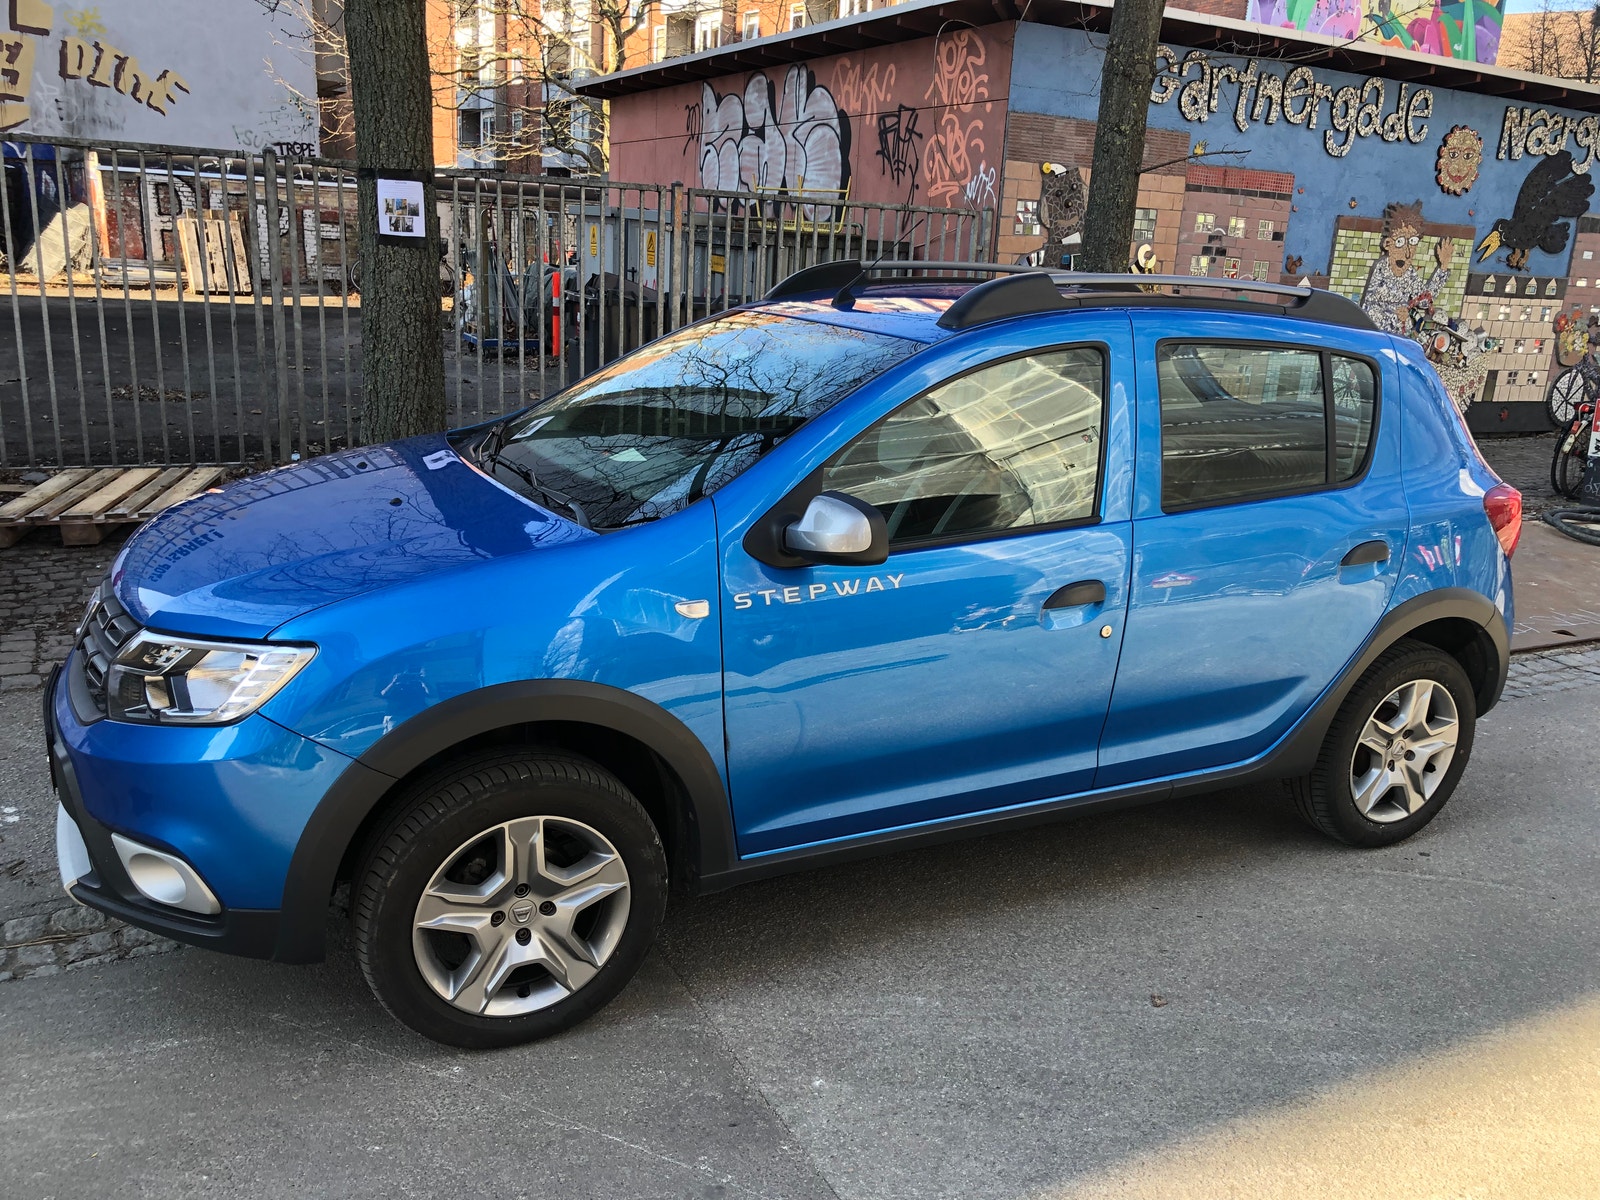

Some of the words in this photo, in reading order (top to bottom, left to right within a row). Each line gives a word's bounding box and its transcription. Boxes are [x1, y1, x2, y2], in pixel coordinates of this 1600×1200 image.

[1149, 44, 1434, 158] Gartnergade
[1496, 106, 1600, 175] Nærg
[733, 573, 904, 610] STEPWAY
